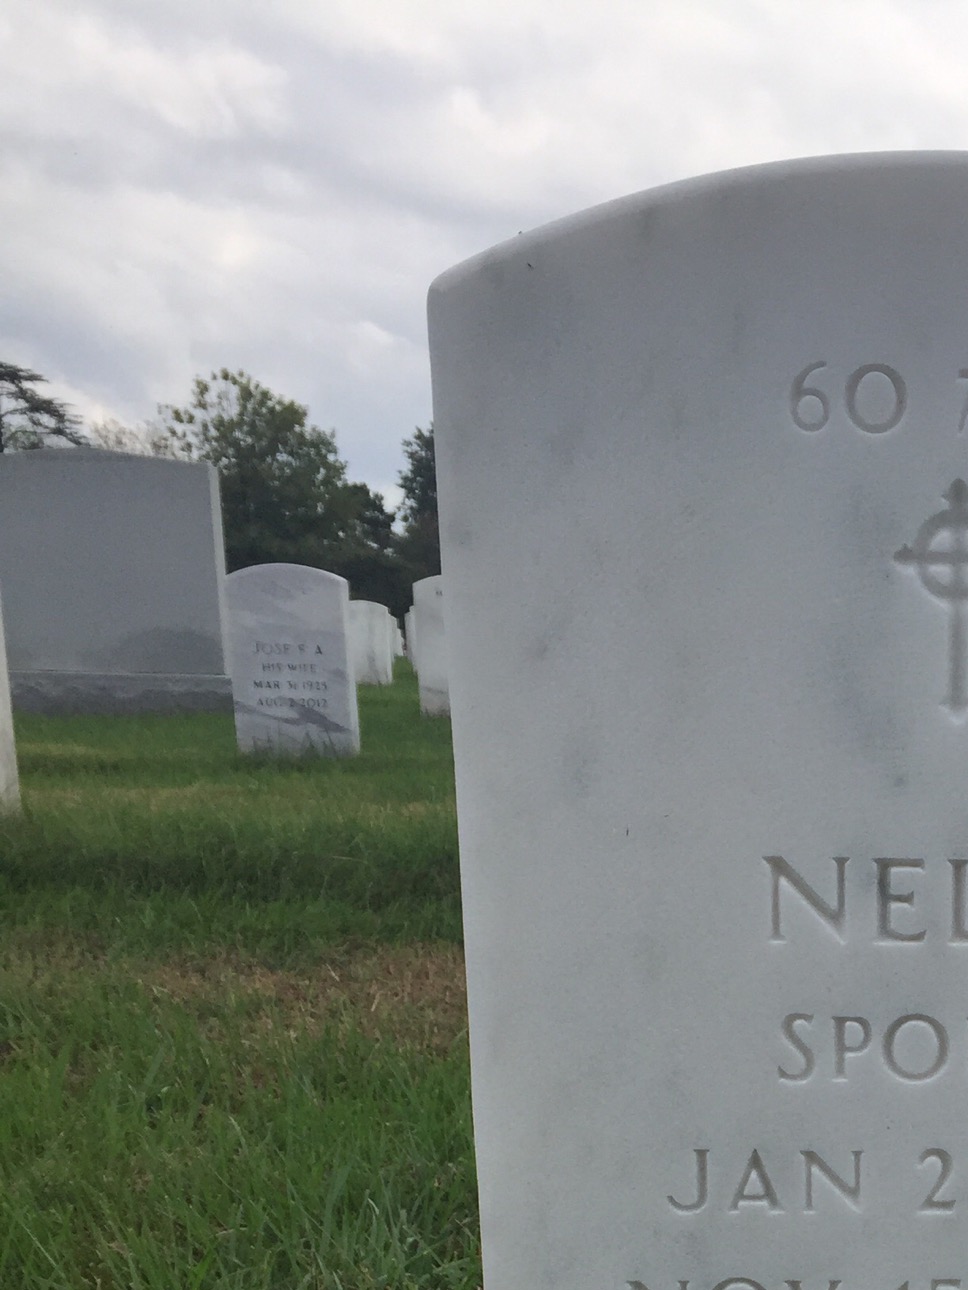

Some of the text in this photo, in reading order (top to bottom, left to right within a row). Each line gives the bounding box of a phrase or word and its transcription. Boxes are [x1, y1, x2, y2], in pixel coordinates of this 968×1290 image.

[790, 360, 908, 435] 60
[253, 680, 280, 690] MAR
[667, 1148, 863, 1214] JAN
